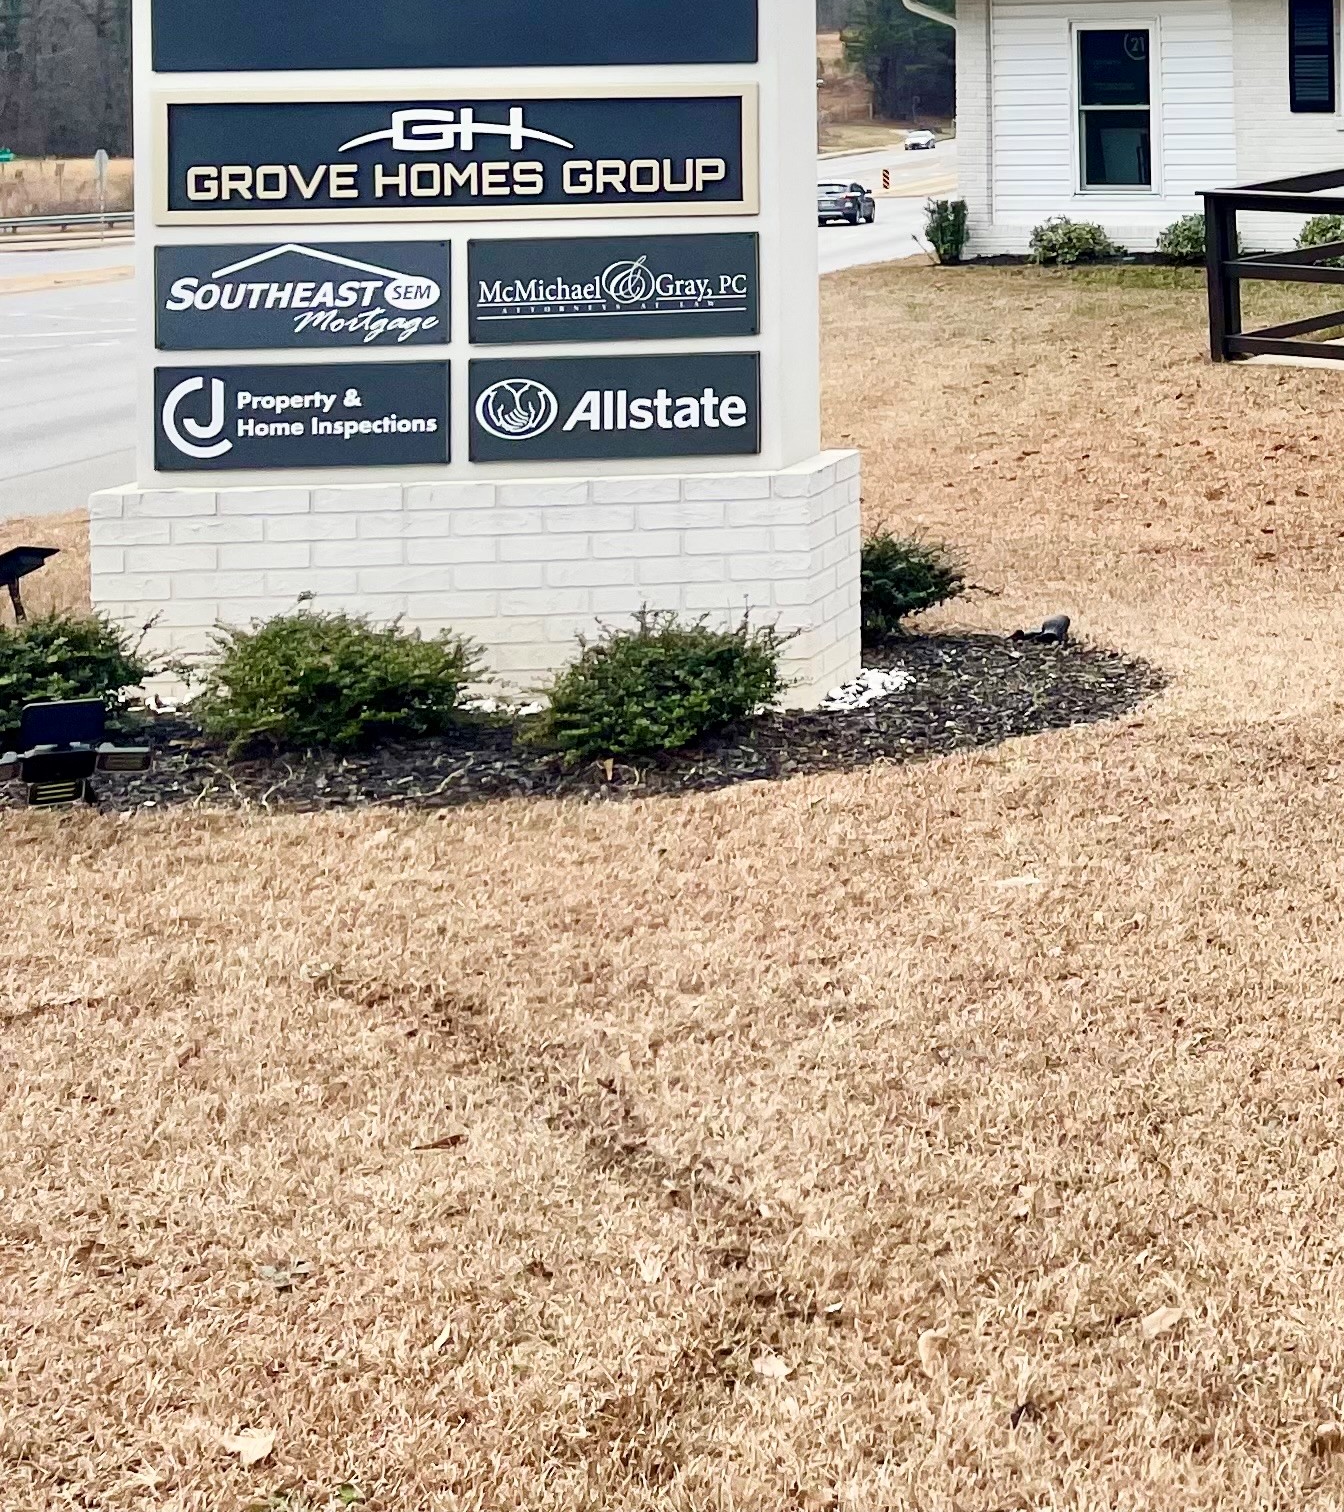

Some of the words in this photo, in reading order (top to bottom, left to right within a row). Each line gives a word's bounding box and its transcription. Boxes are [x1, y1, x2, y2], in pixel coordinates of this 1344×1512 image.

[392, 106, 523, 152] GH
[186, 163, 359, 201] GROVE
[374, 160, 545, 198] HOMES
[562, 157, 728, 195] GROUP
[165, 276, 384, 312] SOUTHEAST
[391, 284, 432, 301] SEM
[478, 275, 602, 304] McMichael
[655, 273, 713, 302] Gray,
[719, 273, 748, 295] PC
[293, 307, 440, 344] Mortgage
[236, 390, 338, 414] Property
[342, 387, 363, 408] &
[562, 386, 748, 432] Allstate
[236, 418, 305, 438] Home
[311, 413, 438, 440] Inspections
